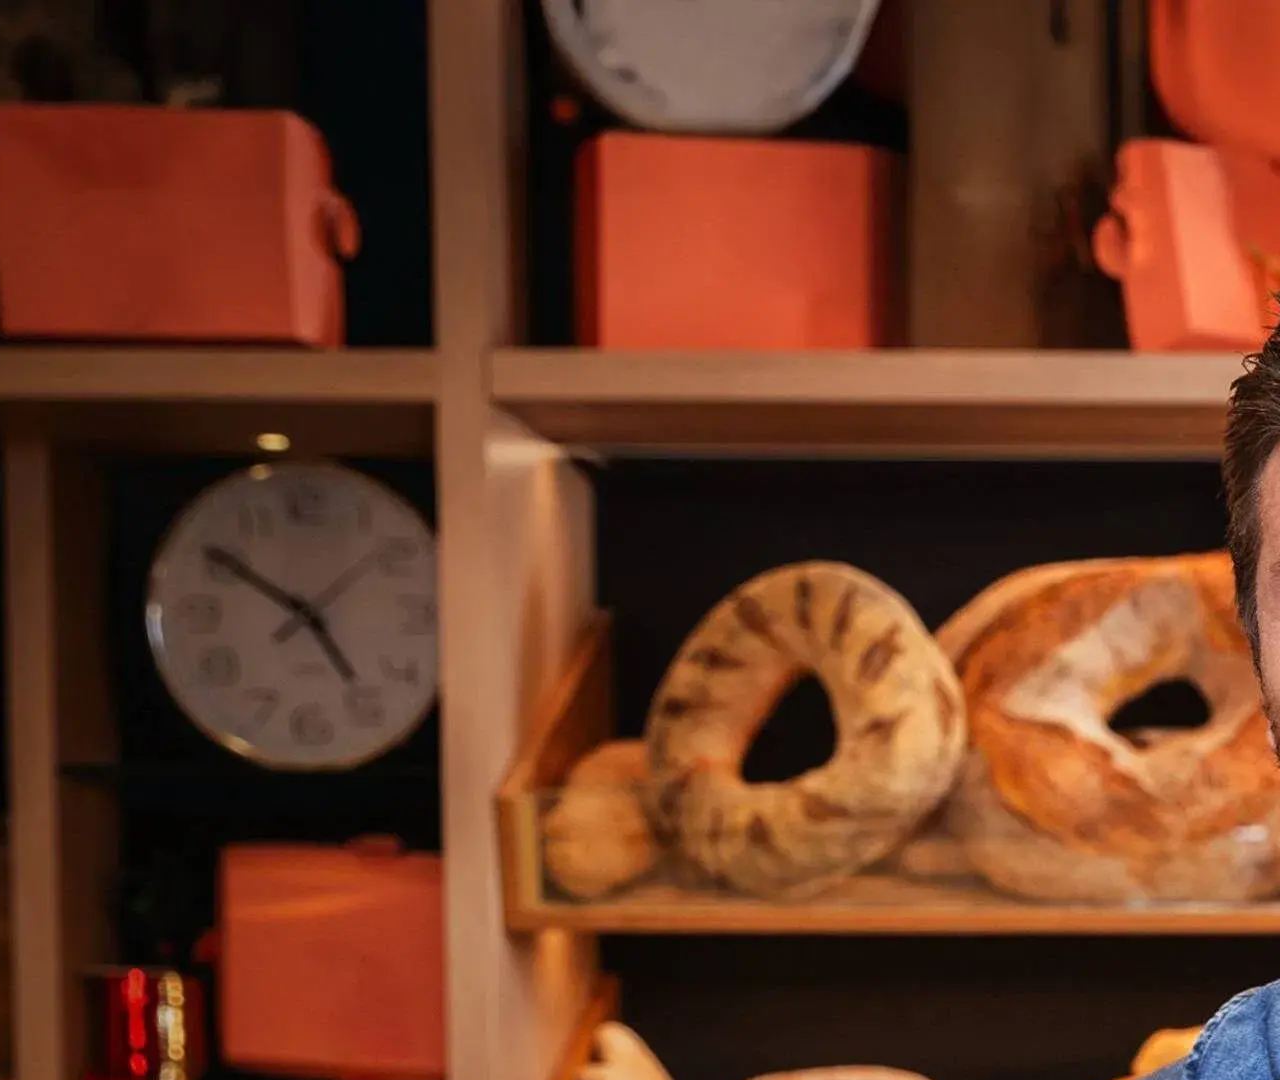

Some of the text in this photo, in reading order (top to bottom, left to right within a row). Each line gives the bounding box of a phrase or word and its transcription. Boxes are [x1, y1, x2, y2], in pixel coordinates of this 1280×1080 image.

[378, 653, 420, 688] 4
[241, 686, 280, 733] 7
[288, 702, 336, 746] 6
